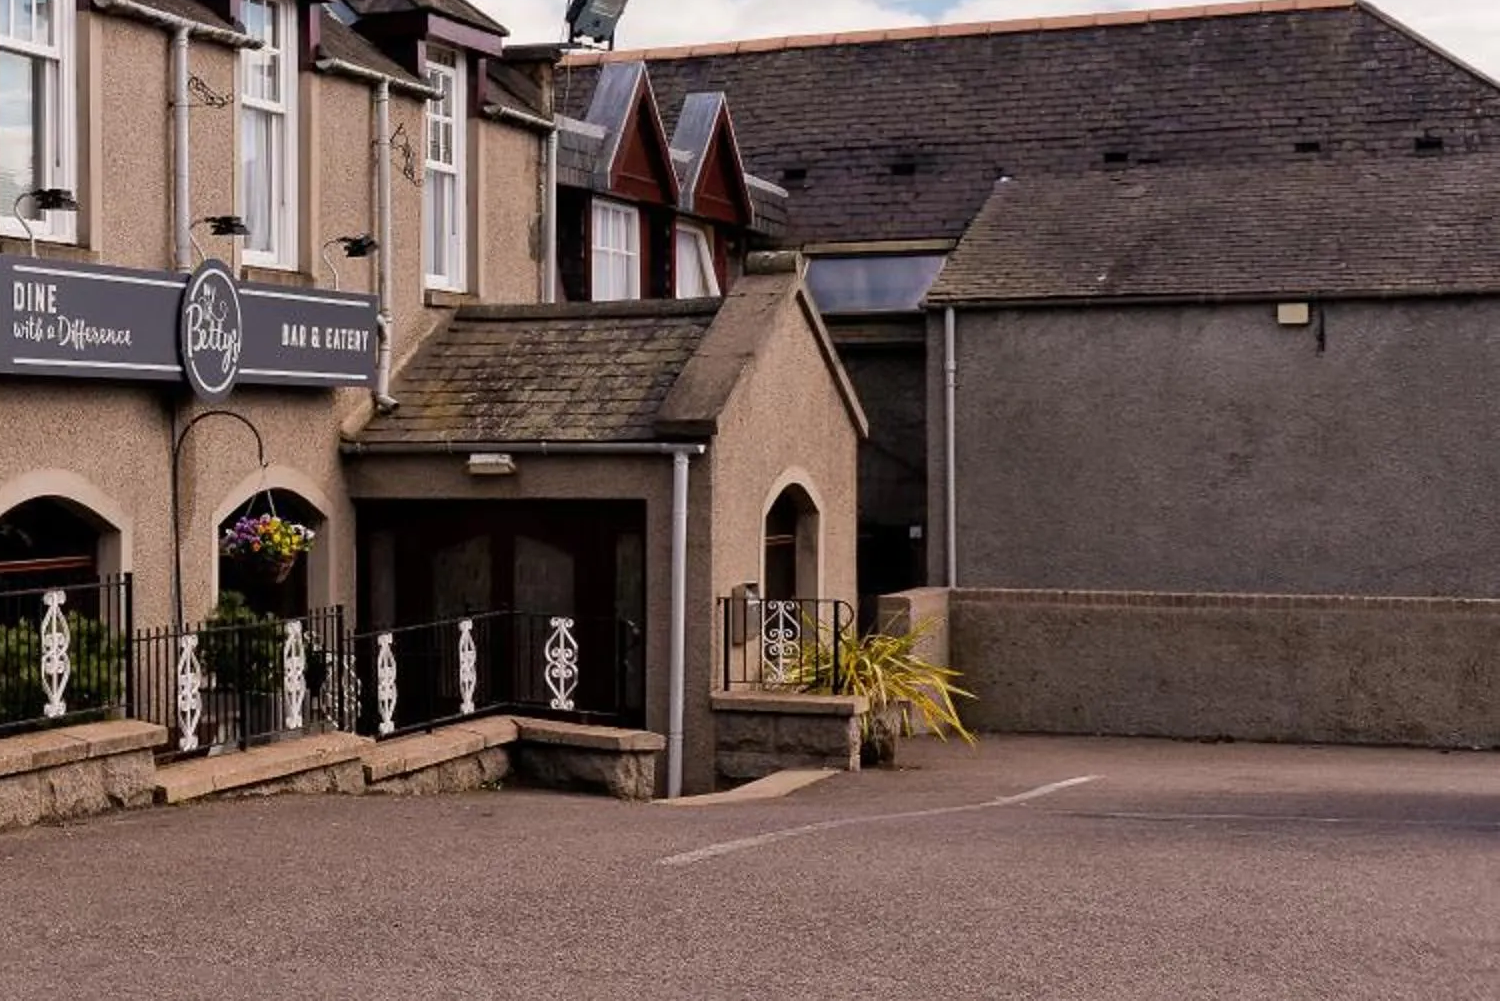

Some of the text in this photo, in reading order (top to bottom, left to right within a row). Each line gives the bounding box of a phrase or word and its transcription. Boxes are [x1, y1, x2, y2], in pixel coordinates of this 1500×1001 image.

[13, 281, 57, 314] DINE
[13, 315, 132, 350] with a Difference
[282, 323, 369, 352] BAR & EATERY
